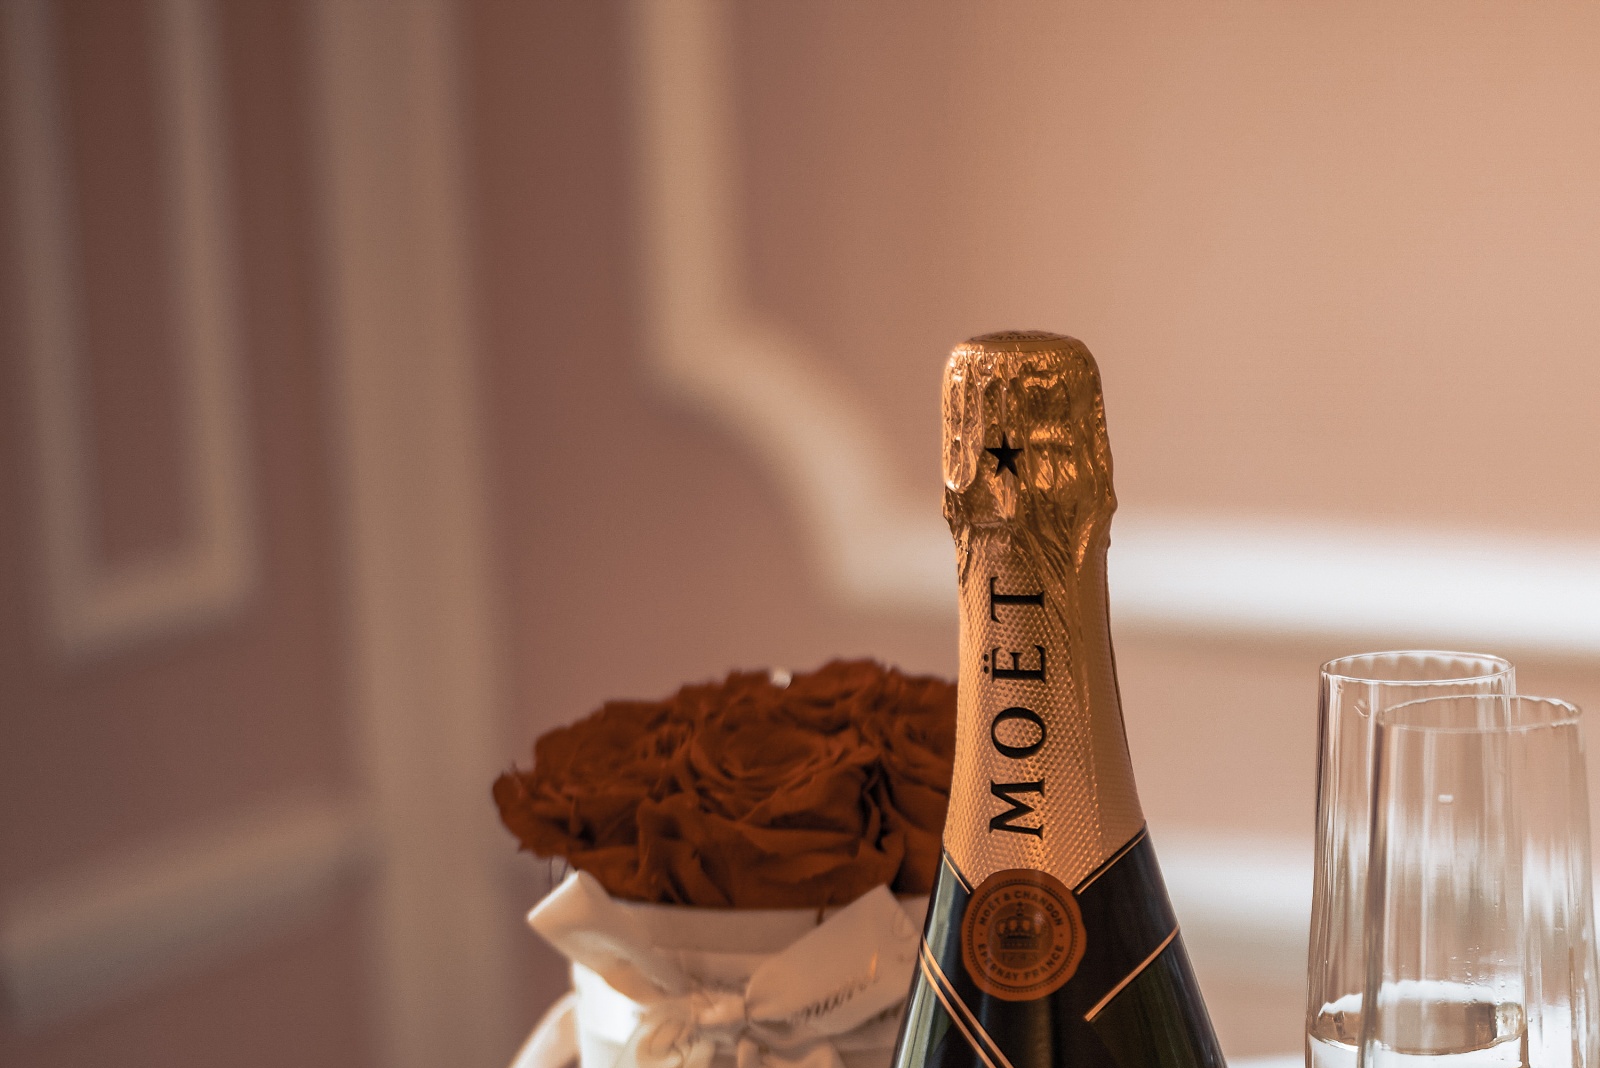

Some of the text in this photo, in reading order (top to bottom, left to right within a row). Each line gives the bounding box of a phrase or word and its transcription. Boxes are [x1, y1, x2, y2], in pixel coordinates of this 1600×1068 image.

[983, 576, 1047, 839] MOËT
[1013, 890, 1064, 927] CHANDON
[1023, 944, 1065, 980] FRANCE
